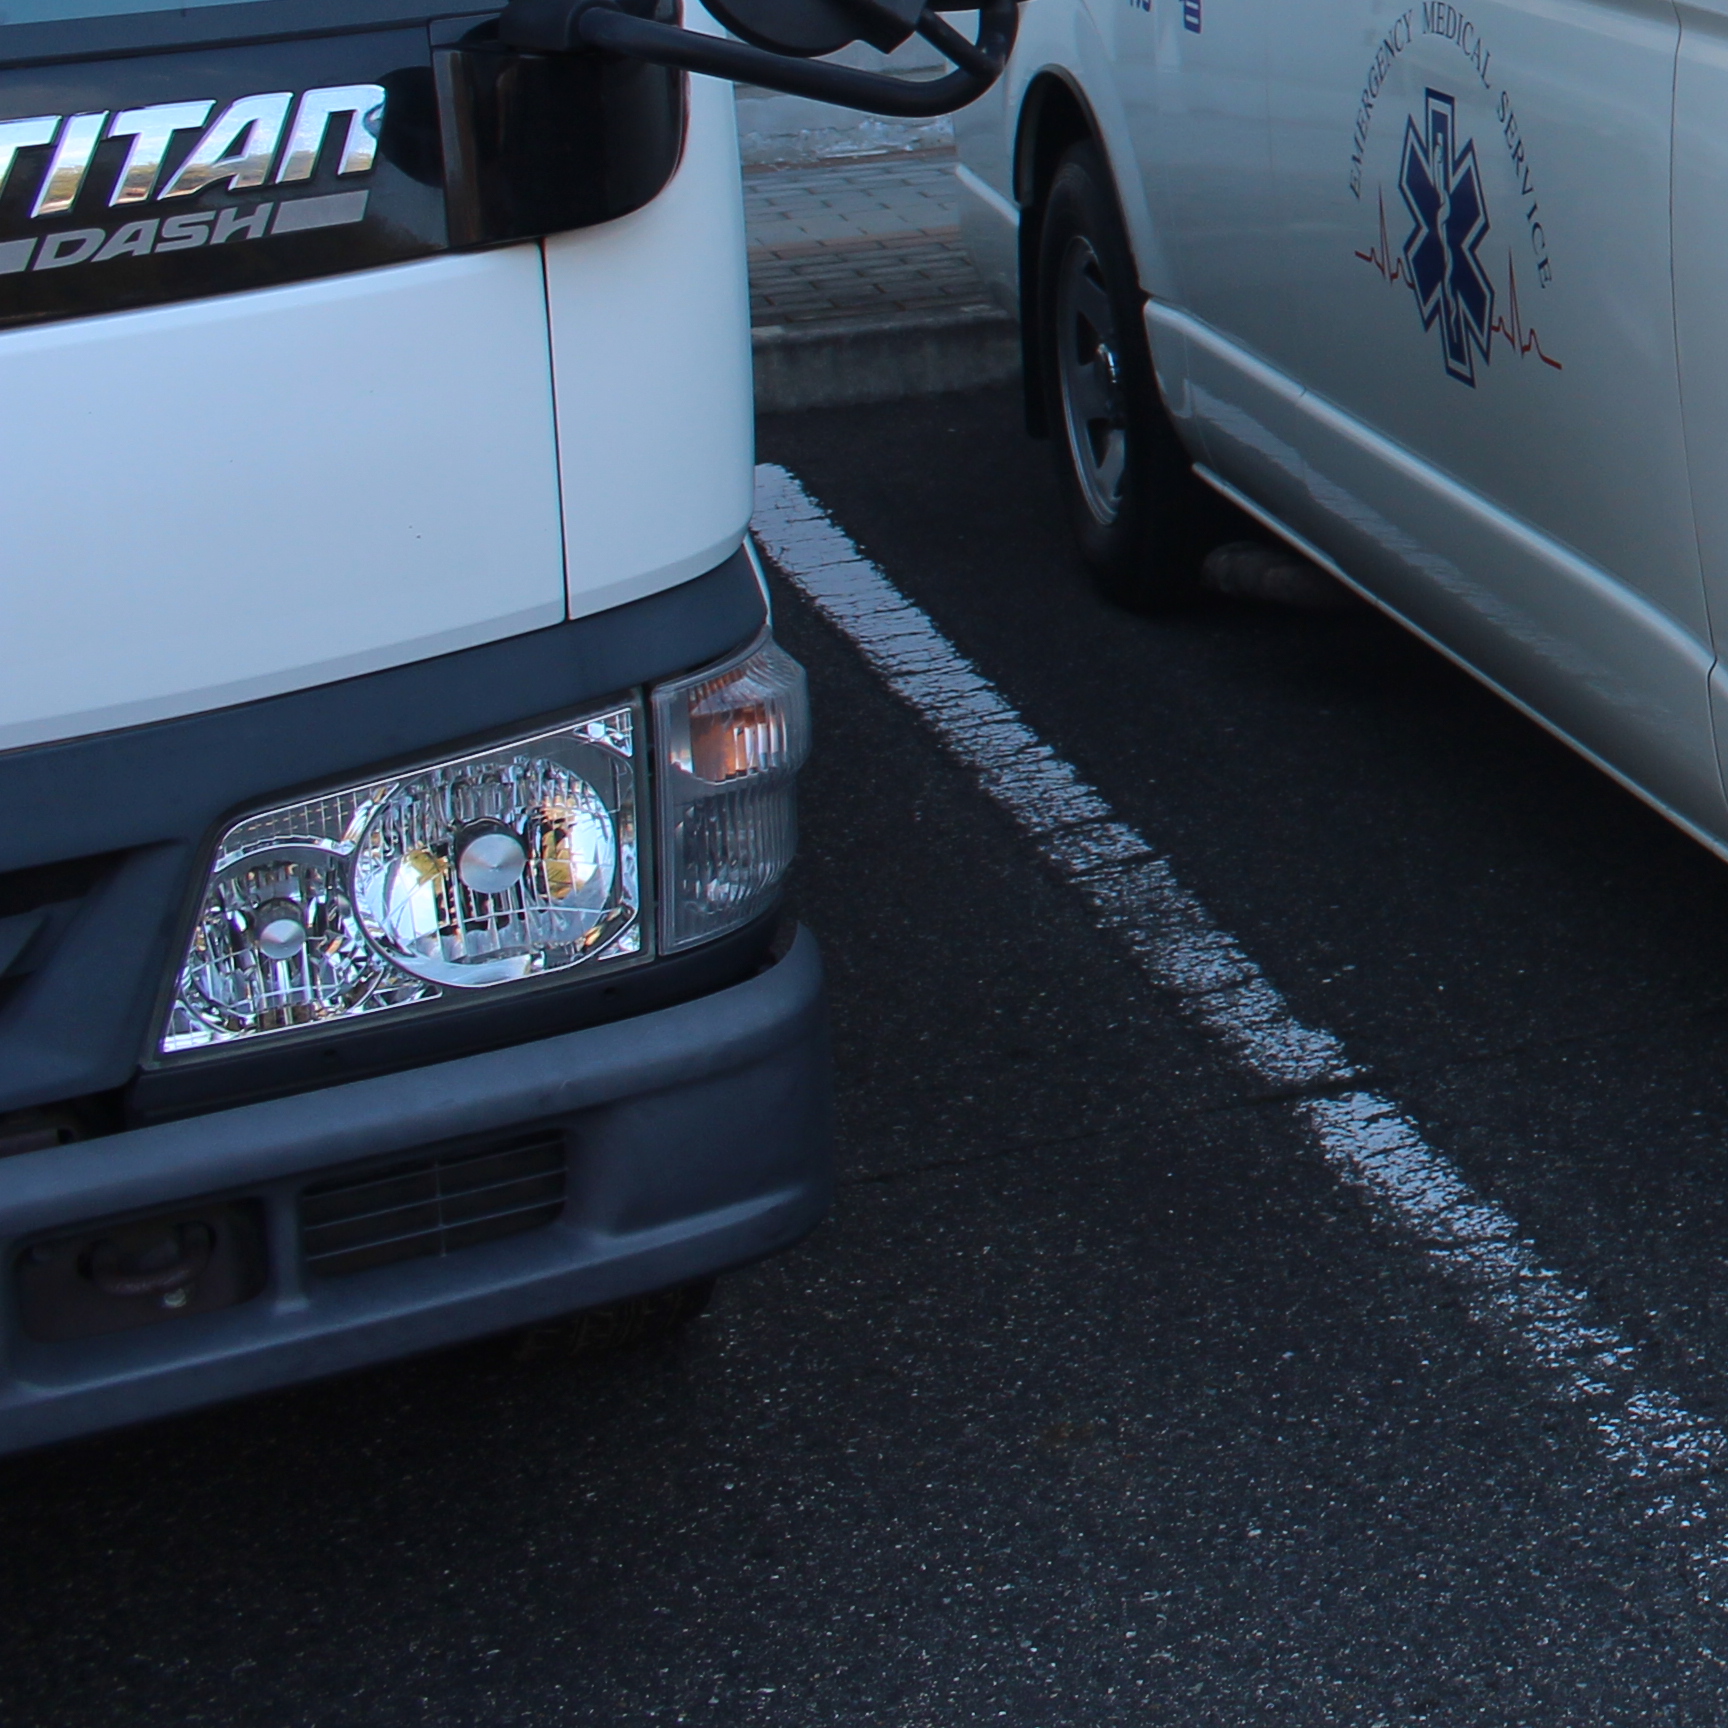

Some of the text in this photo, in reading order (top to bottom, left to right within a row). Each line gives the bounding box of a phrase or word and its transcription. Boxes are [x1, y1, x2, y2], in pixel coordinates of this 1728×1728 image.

[1350, 1, 1553, 289] EMERGENCY MEDICAL SERVICE
[32, 202, 274, 271] DASH
